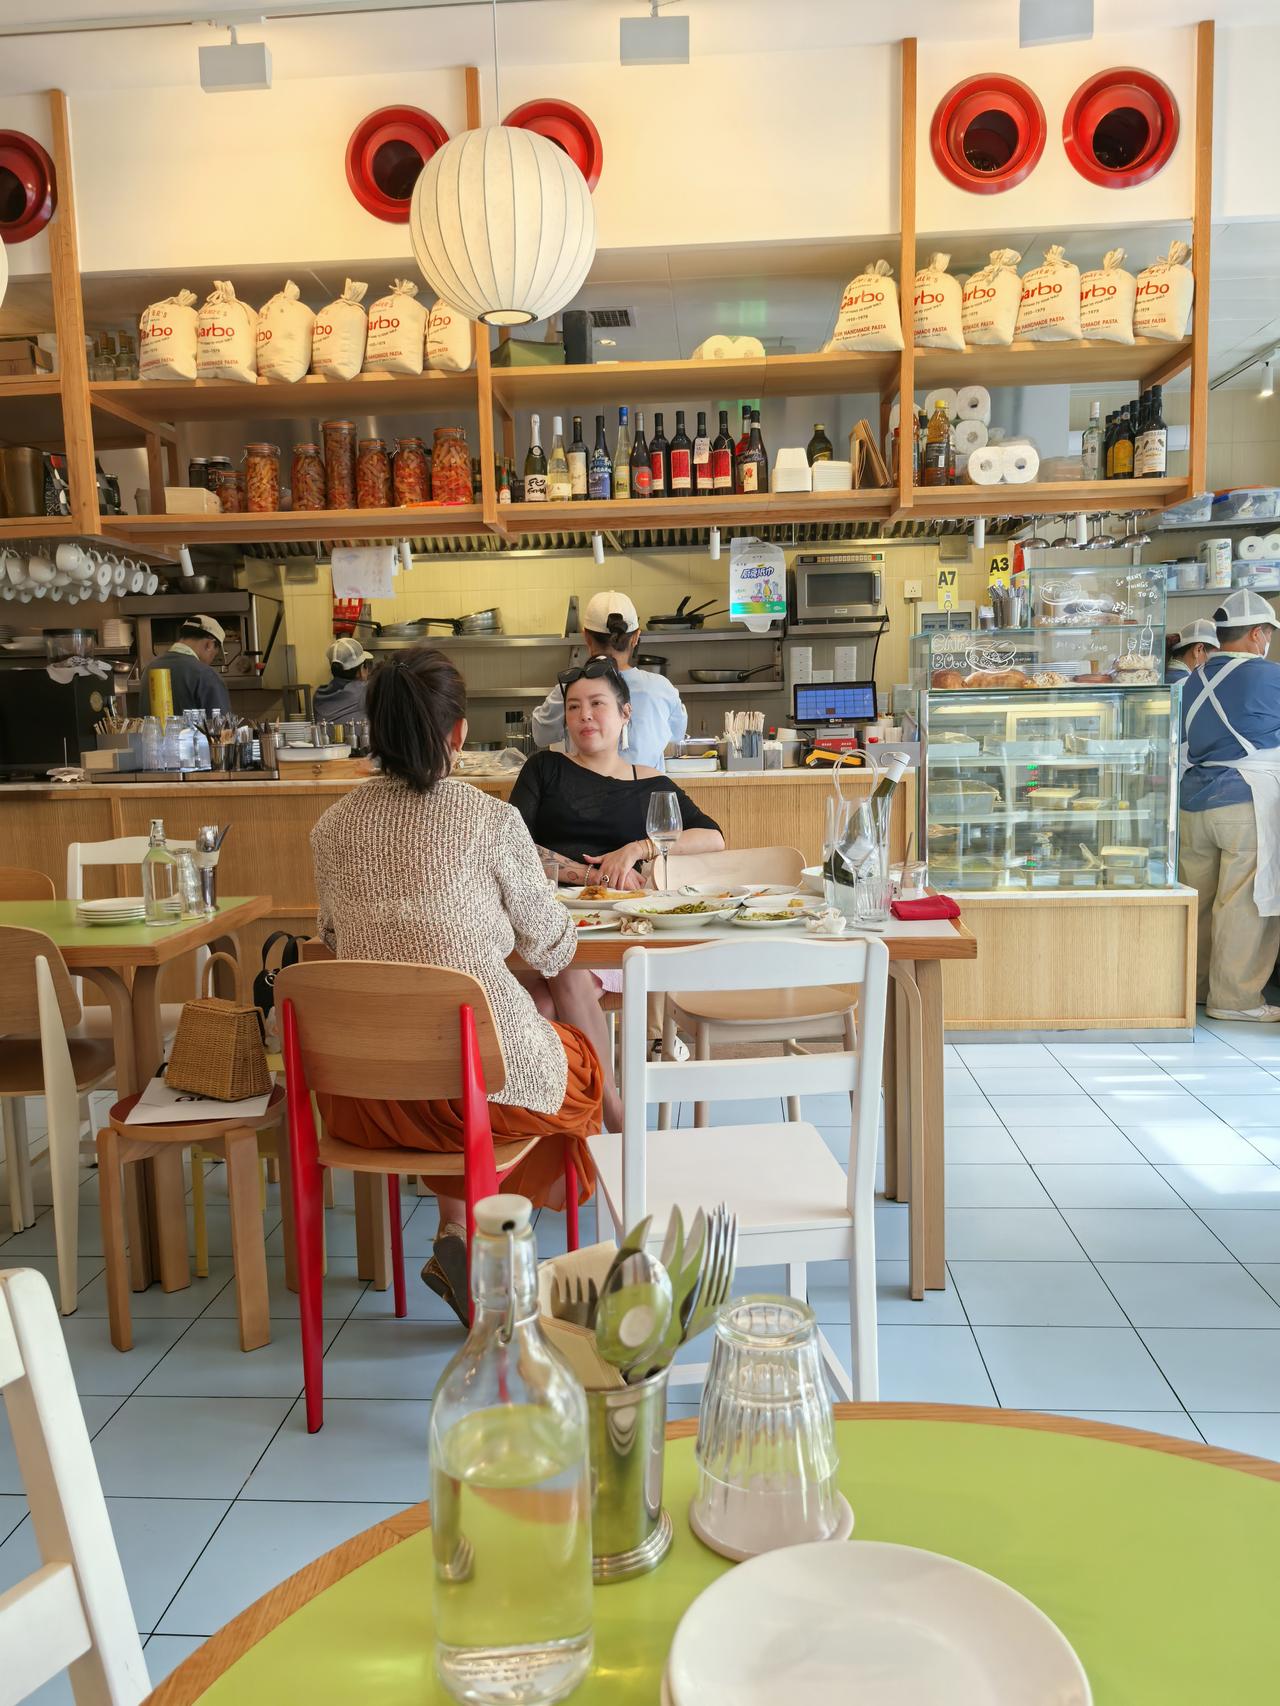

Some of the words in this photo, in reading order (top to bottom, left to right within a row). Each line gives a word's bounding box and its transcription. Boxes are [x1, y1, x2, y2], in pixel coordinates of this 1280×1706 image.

[914, 290, 945, 306] rbo
[990, 558, 1009, 573] A3
[938, 571, 956, 586] A7
